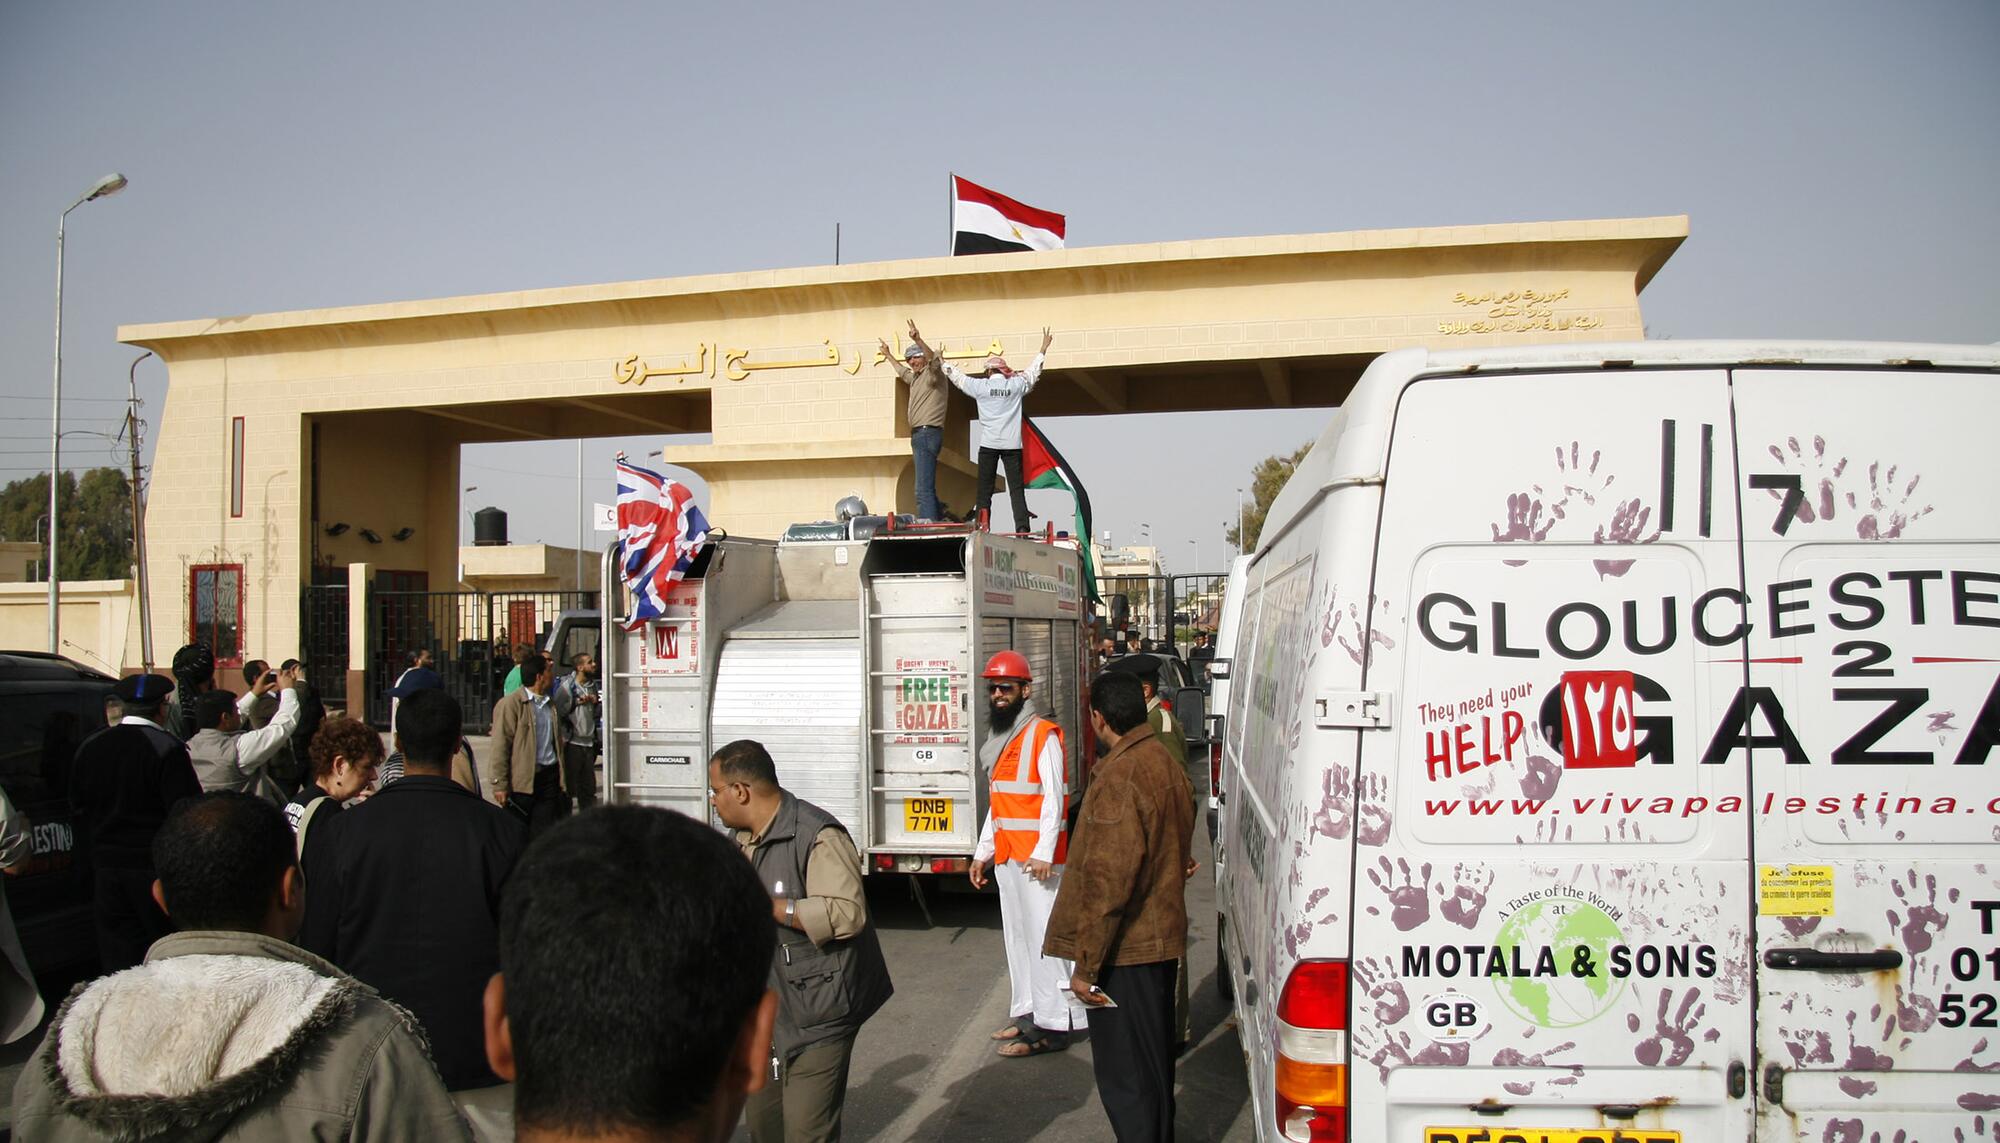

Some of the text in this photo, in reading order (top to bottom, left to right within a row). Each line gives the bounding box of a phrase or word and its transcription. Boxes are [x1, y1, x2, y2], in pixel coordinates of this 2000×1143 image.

[725, 336, 861, 381] رفح
[1417, 570, 2000, 660] GLOUCESTE
[1832, 641, 1894, 677] 2
[903, 678, 950, 702] FREE
[1418, 681, 1532, 725] They need your
[903, 704, 950, 730] GAZA
[649, 756, 686, 764] CARMICHAEL
[916, 750, 933, 760] GB
[1425, 710, 1524, 781] HELP
[909, 816, 948, 831] 771W
[912, 800, 946, 814] ONB
[1498, 884, 1624, 922] A Taste of the World
[1552, 904, 1566, 915] at
[1401, 944, 1717, 978] MOTALA & SONS
[1951, 947, 2000, 982] 01
[1427, 1002, 1477, 1028] GB
[1938, 993, 1998, 1028] 52
